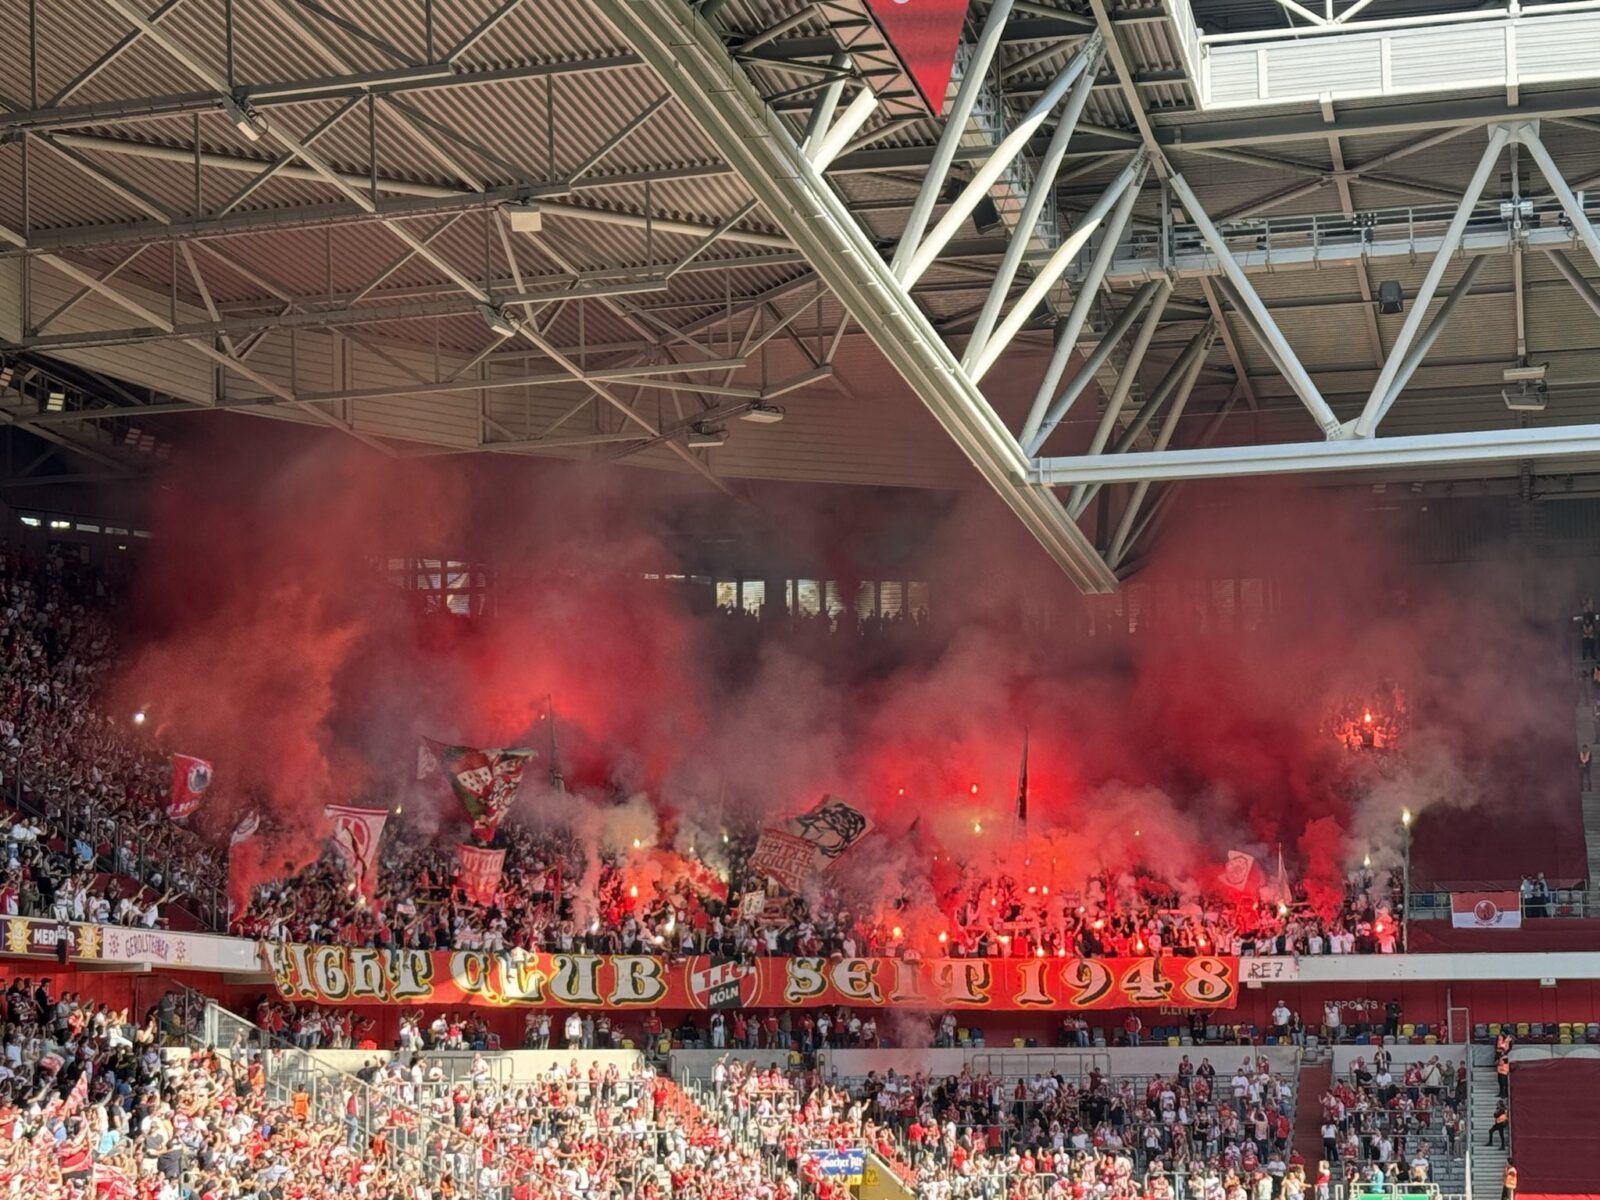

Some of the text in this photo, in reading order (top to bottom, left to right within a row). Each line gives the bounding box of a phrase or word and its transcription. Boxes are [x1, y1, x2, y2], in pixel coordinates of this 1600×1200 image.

[450, 950, 668, 1006] CLUB
[784, 956, 992, 1005] SEIT
[1013, 956, 1233, 1006] 1948
[709, 985, 739, 1006] KÖLN
